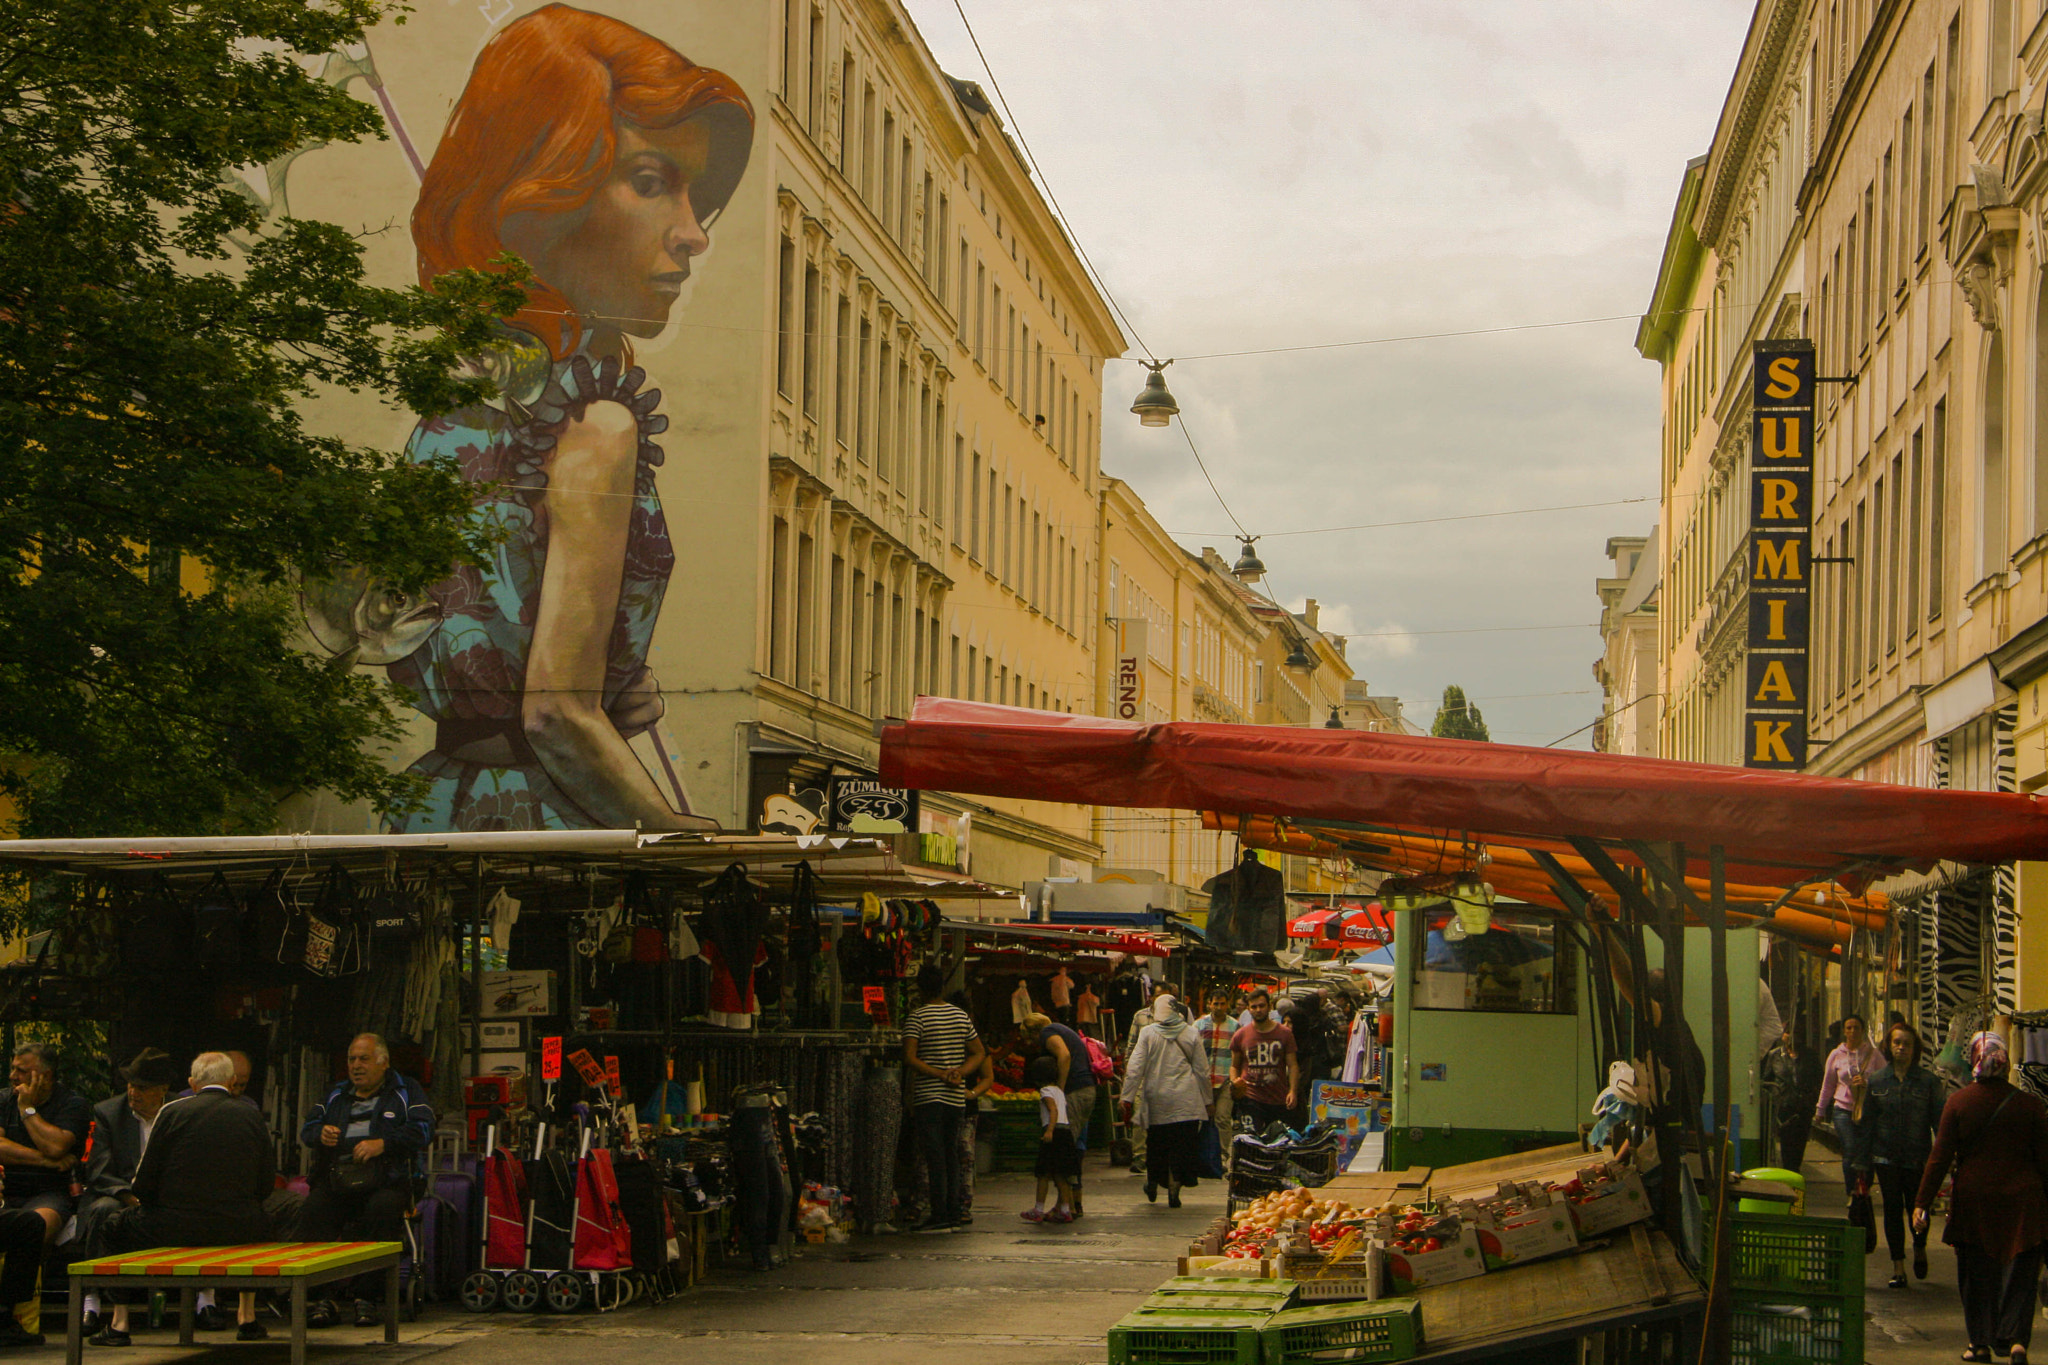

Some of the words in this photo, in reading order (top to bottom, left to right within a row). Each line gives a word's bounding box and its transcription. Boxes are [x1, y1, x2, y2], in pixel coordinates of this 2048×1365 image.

[1753, 357, 1803, 763] SURMIAK
[1119, 657, 1137, 720] RENO
[375, 918, 405, 927] SPORT
